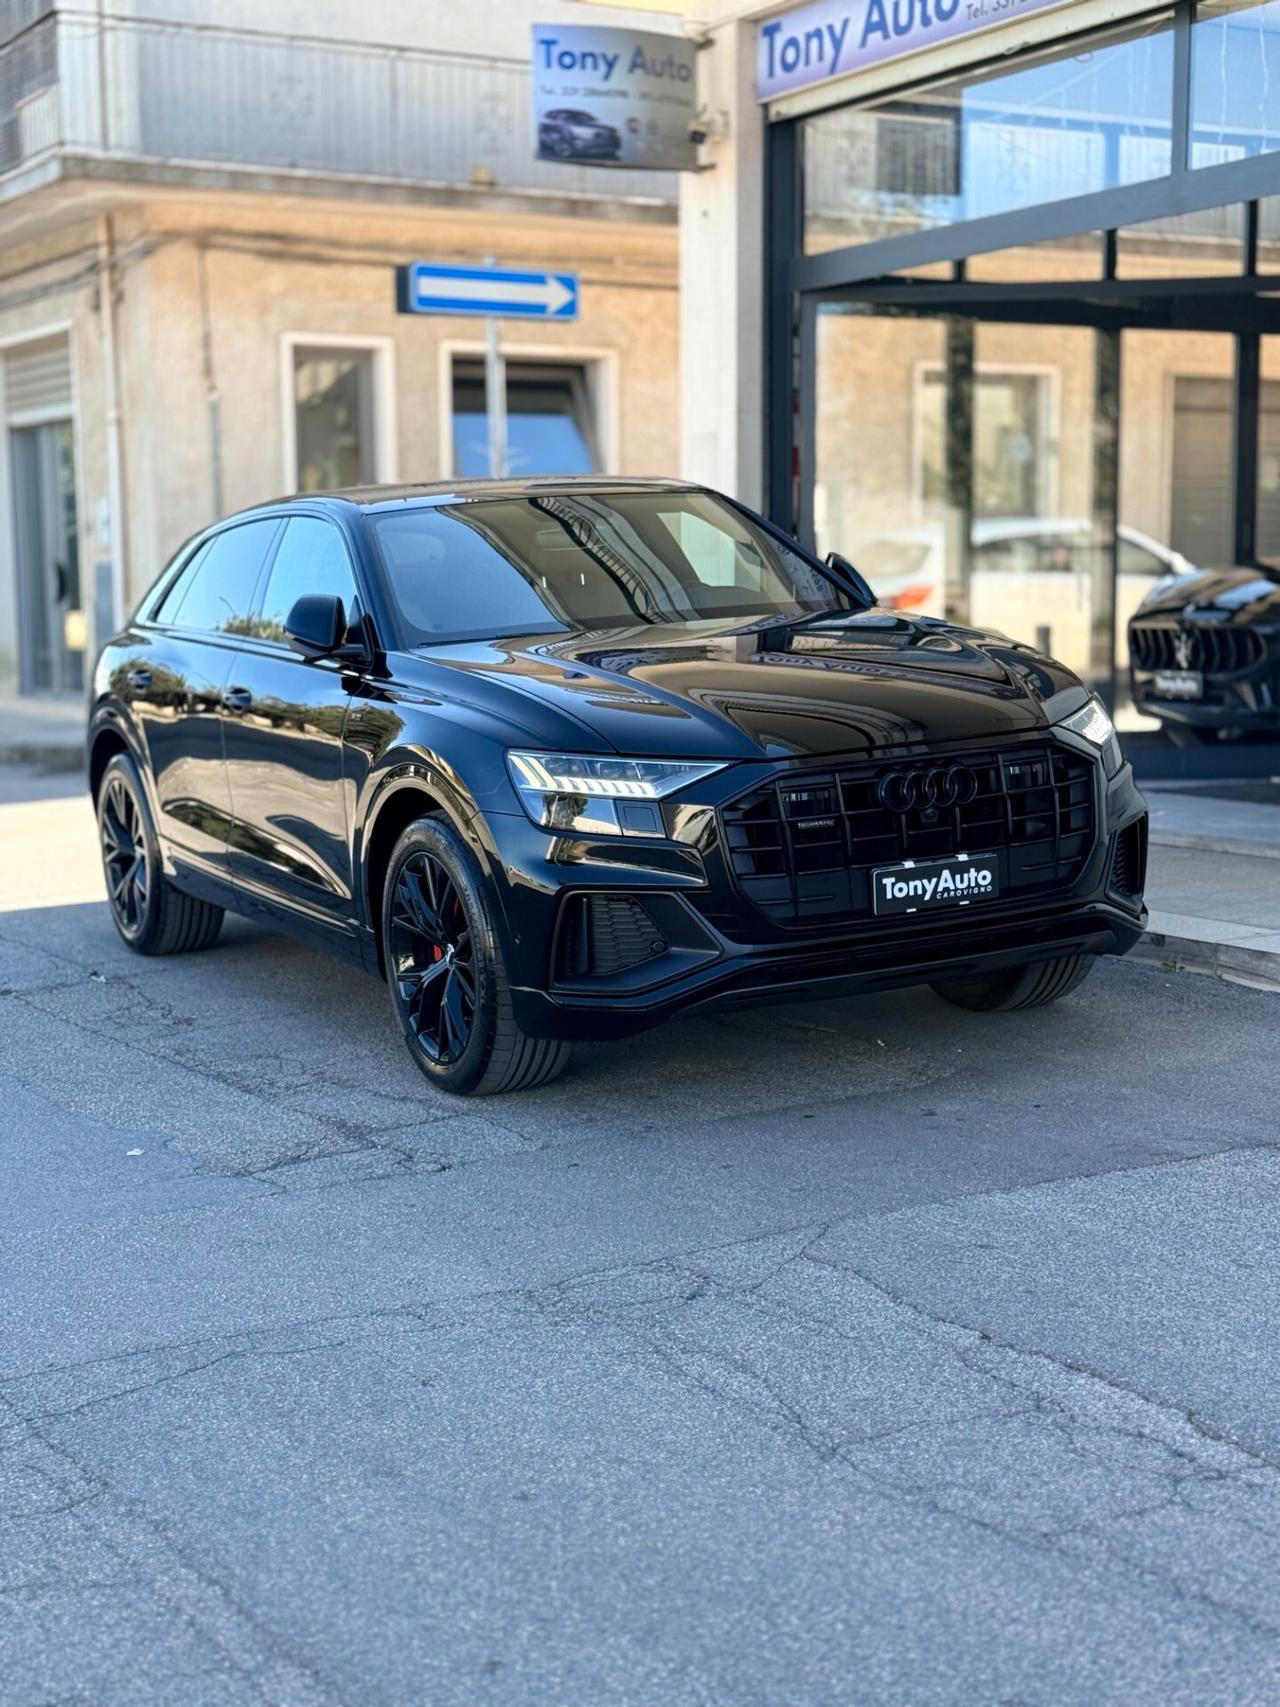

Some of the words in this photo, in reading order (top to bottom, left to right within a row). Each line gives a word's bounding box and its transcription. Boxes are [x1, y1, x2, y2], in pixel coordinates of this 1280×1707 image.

[966, 1, 988, 20] Tel.
[763, 22, 850, 79] Tony
[860, 0, 959, 49] Auto
[539, 39, 619, 81] Tony
[628, 46, 692, 82] Auto
[936, 885, 993, 899] CAROVIGNO
